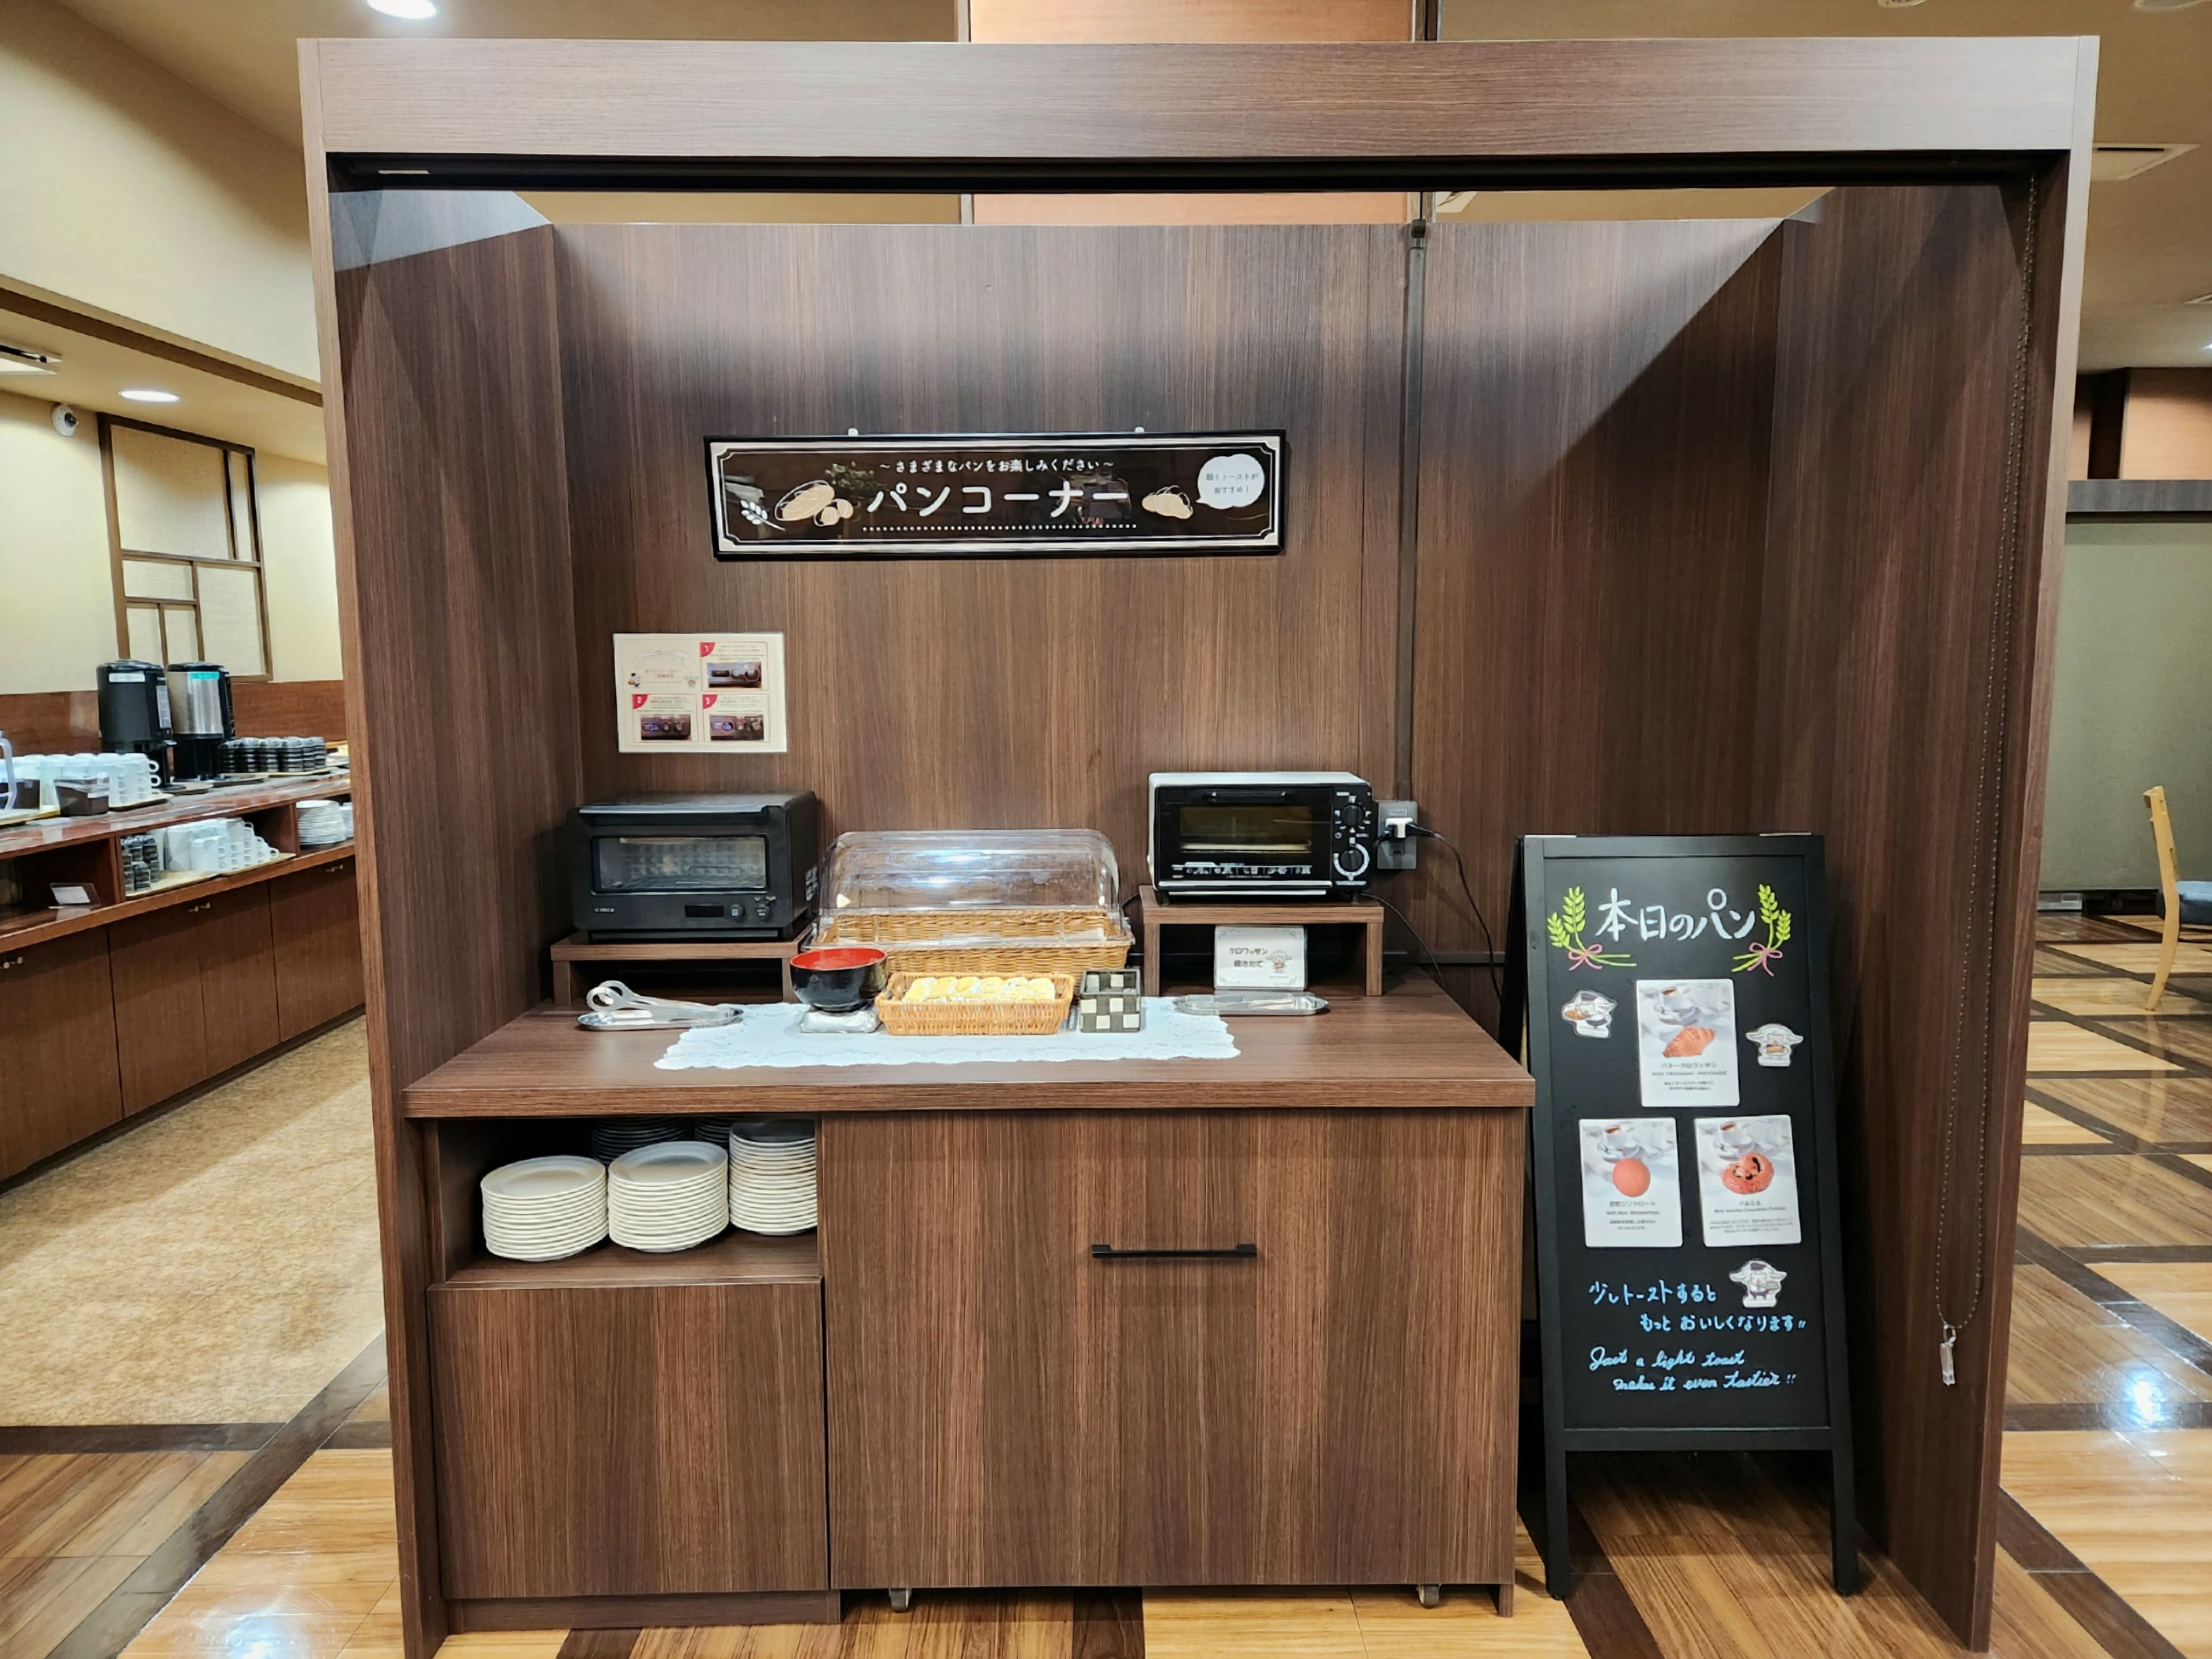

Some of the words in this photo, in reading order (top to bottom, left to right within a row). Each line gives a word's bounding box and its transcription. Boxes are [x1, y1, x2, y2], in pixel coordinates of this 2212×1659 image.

[866, 480, 1128, 517] パンコーナー
[1596, 887, 1756, 942] 本日のパン
[1229, 946, 1268, 956] クロワッサン
[1588, 1279, 1717, 1306] 少しトーストすると
[1589, 1346, 1628, 1371] Just
[1635, 1357, 1645, 1367] a
[1650, 1349, 1696, 1371] light
[1701, 1349, 1745, 1367] toast
[1612, 1374, 1656, 1391] makes
[1659, 1376, 1676, 1391] it
[1682, 1378, 1718, 1390] even
